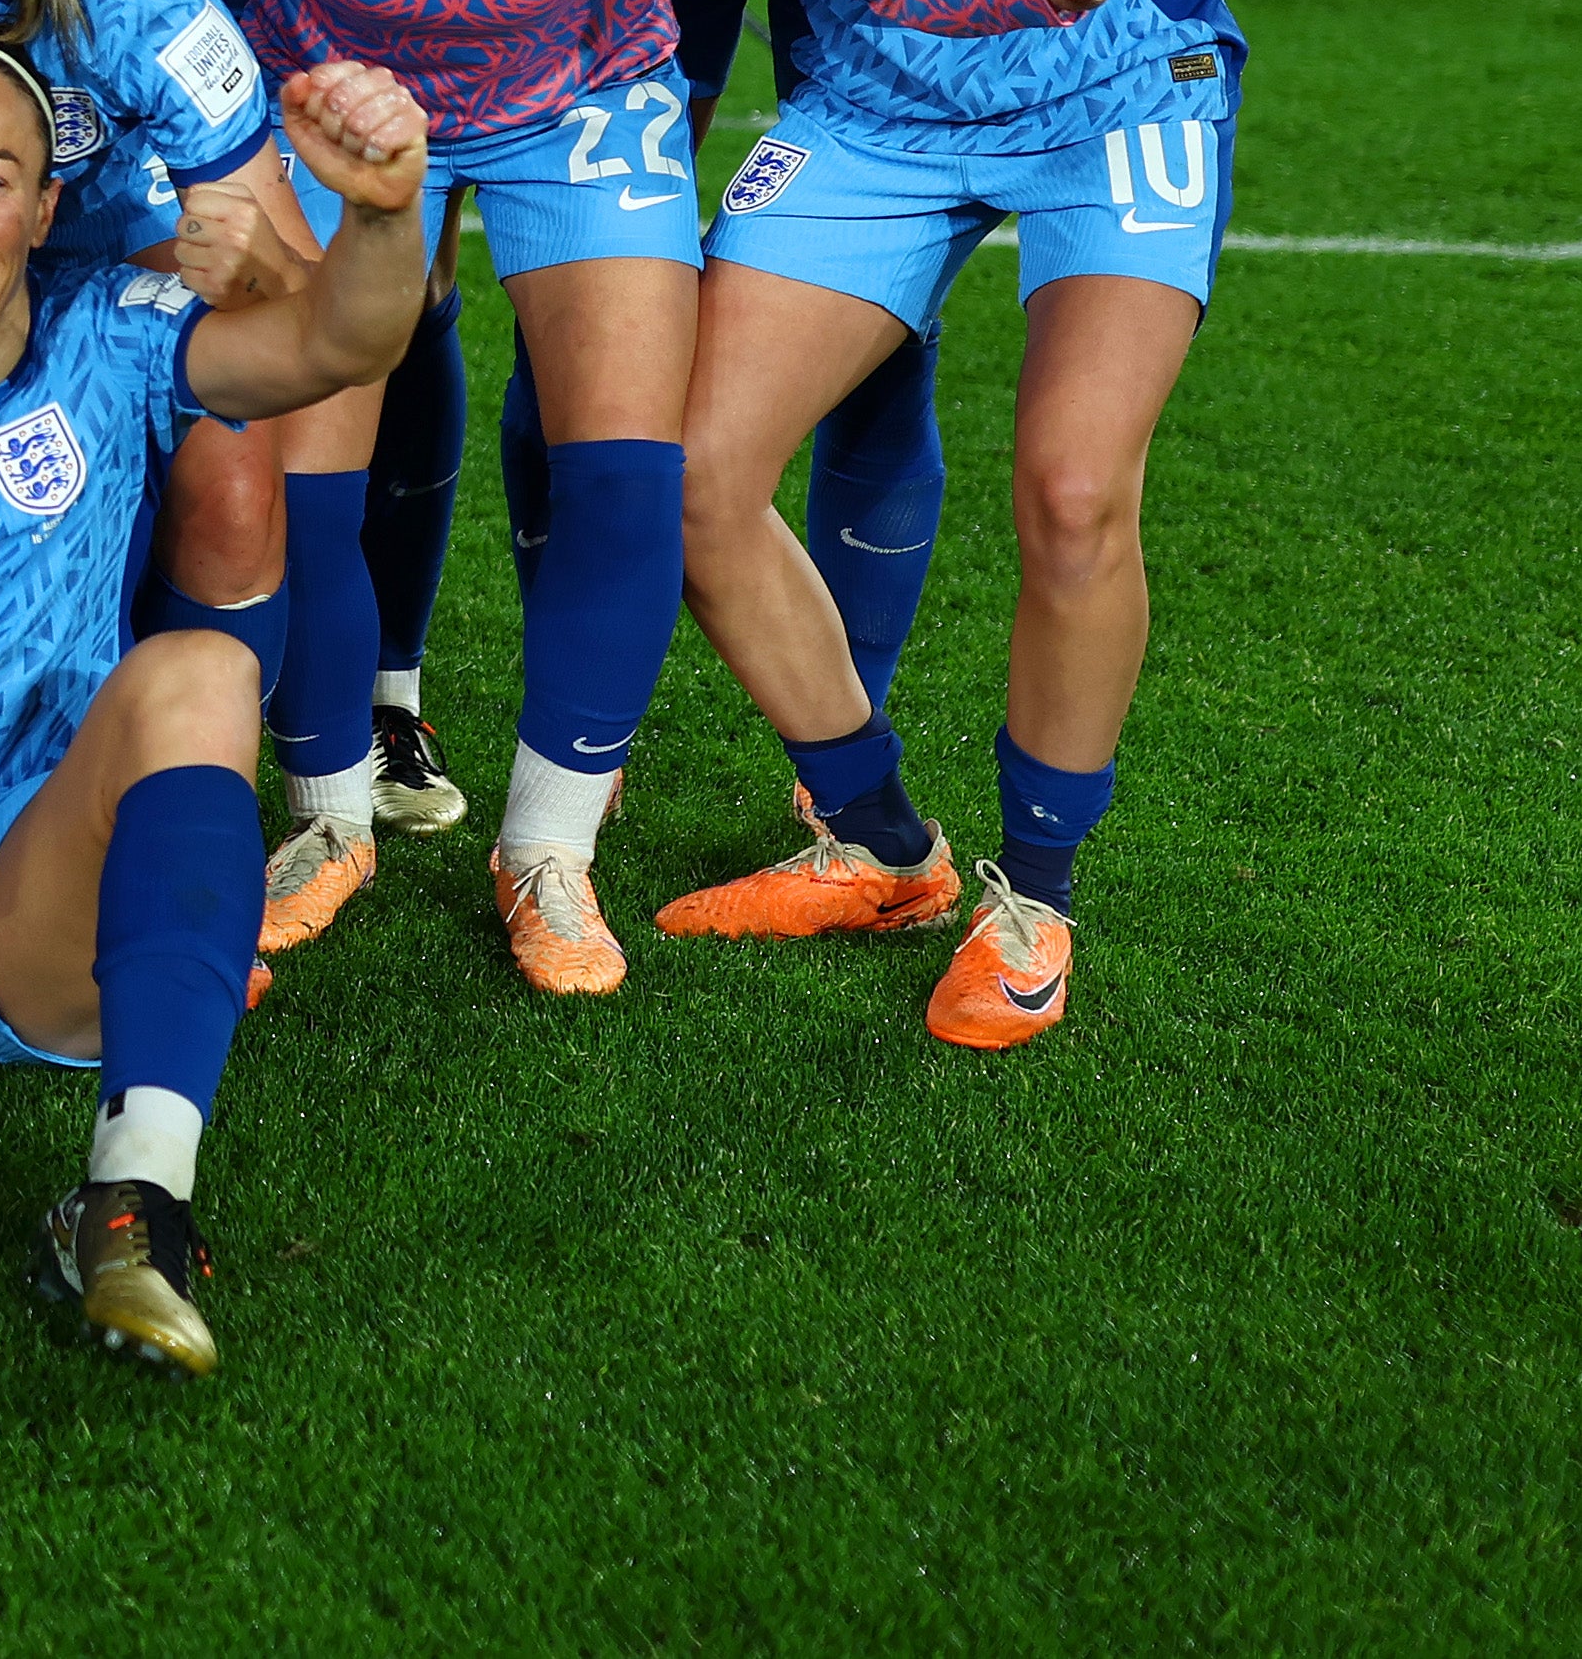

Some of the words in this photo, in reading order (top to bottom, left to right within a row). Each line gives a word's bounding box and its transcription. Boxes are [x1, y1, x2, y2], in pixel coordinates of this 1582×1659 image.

[184, 24, 221, 65] FOOTBALL
[193, 33, 230, 77] UNITES
[559, 82, 689, 184] 22
[1105, 120, 1205, 208] 10
